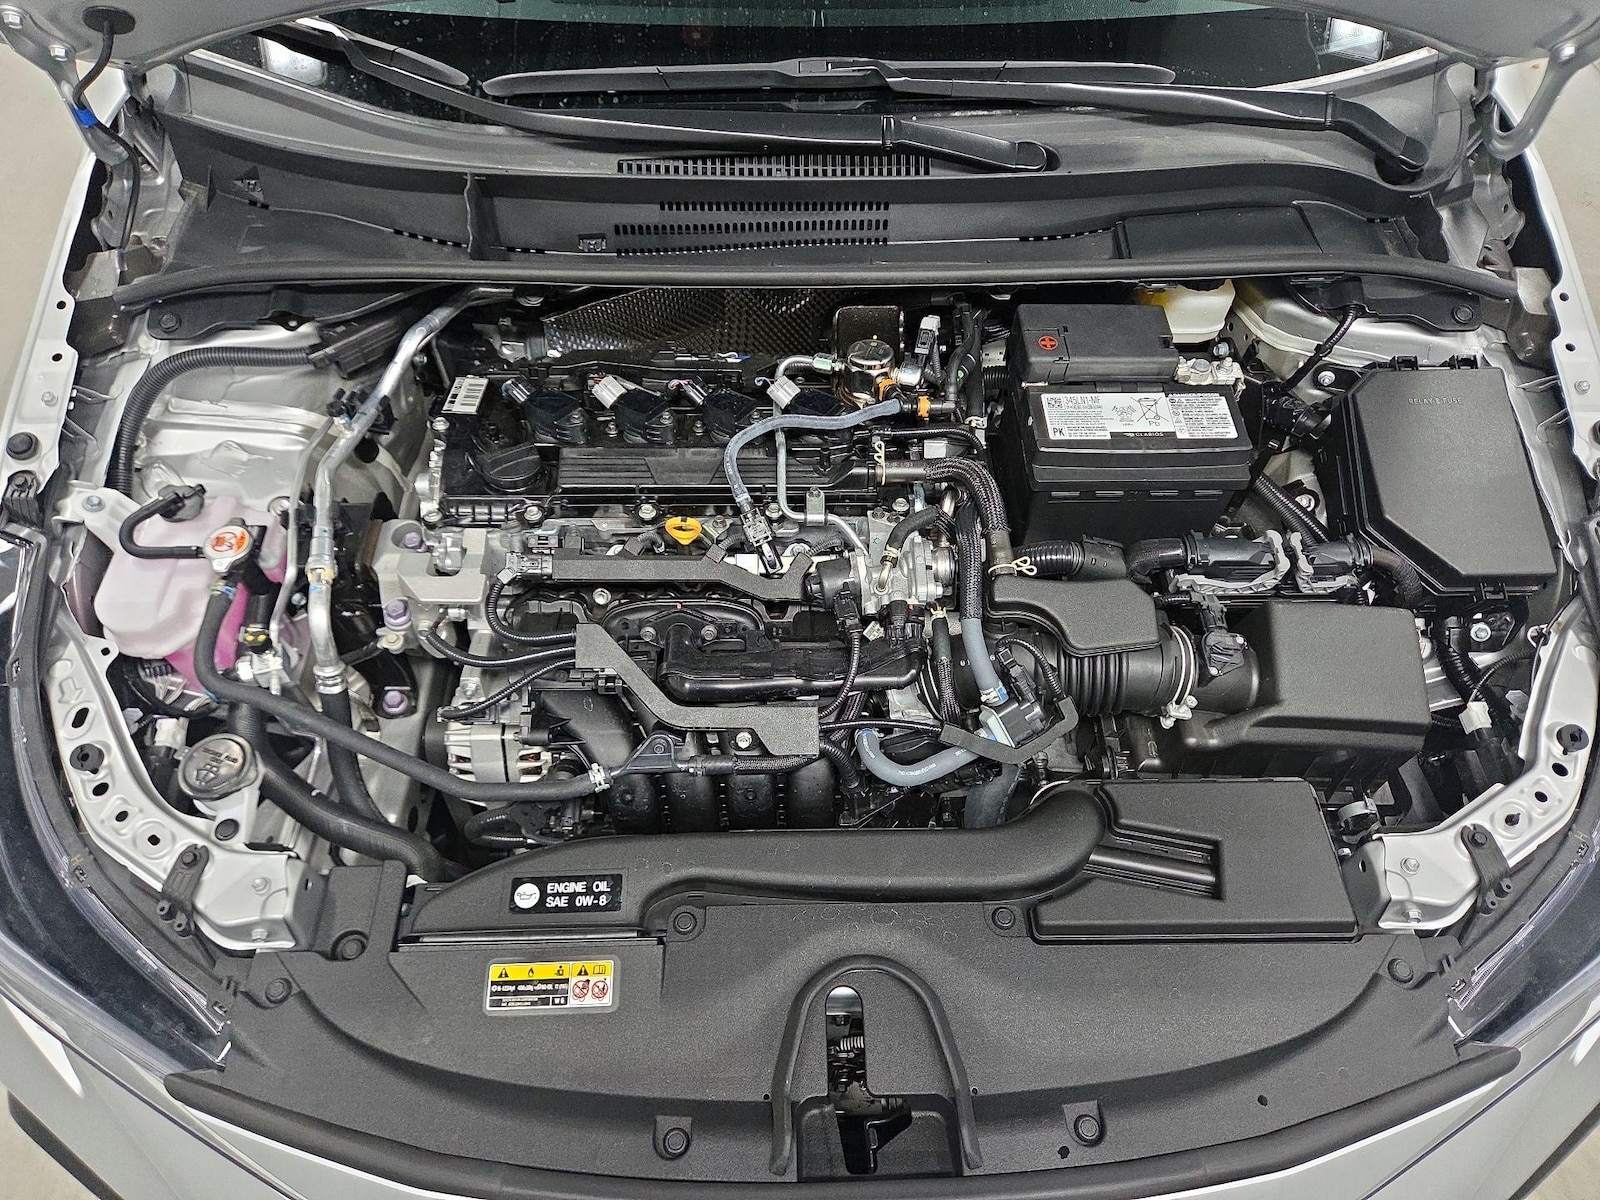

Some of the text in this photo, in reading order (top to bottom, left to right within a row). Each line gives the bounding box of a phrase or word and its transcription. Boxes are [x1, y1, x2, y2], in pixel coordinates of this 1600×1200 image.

[1053, 428, 1065, 436] PK
[546, 880, 611, 894] ENGINE OIL
[545, 895, 607, 907] SAE 0W-8
